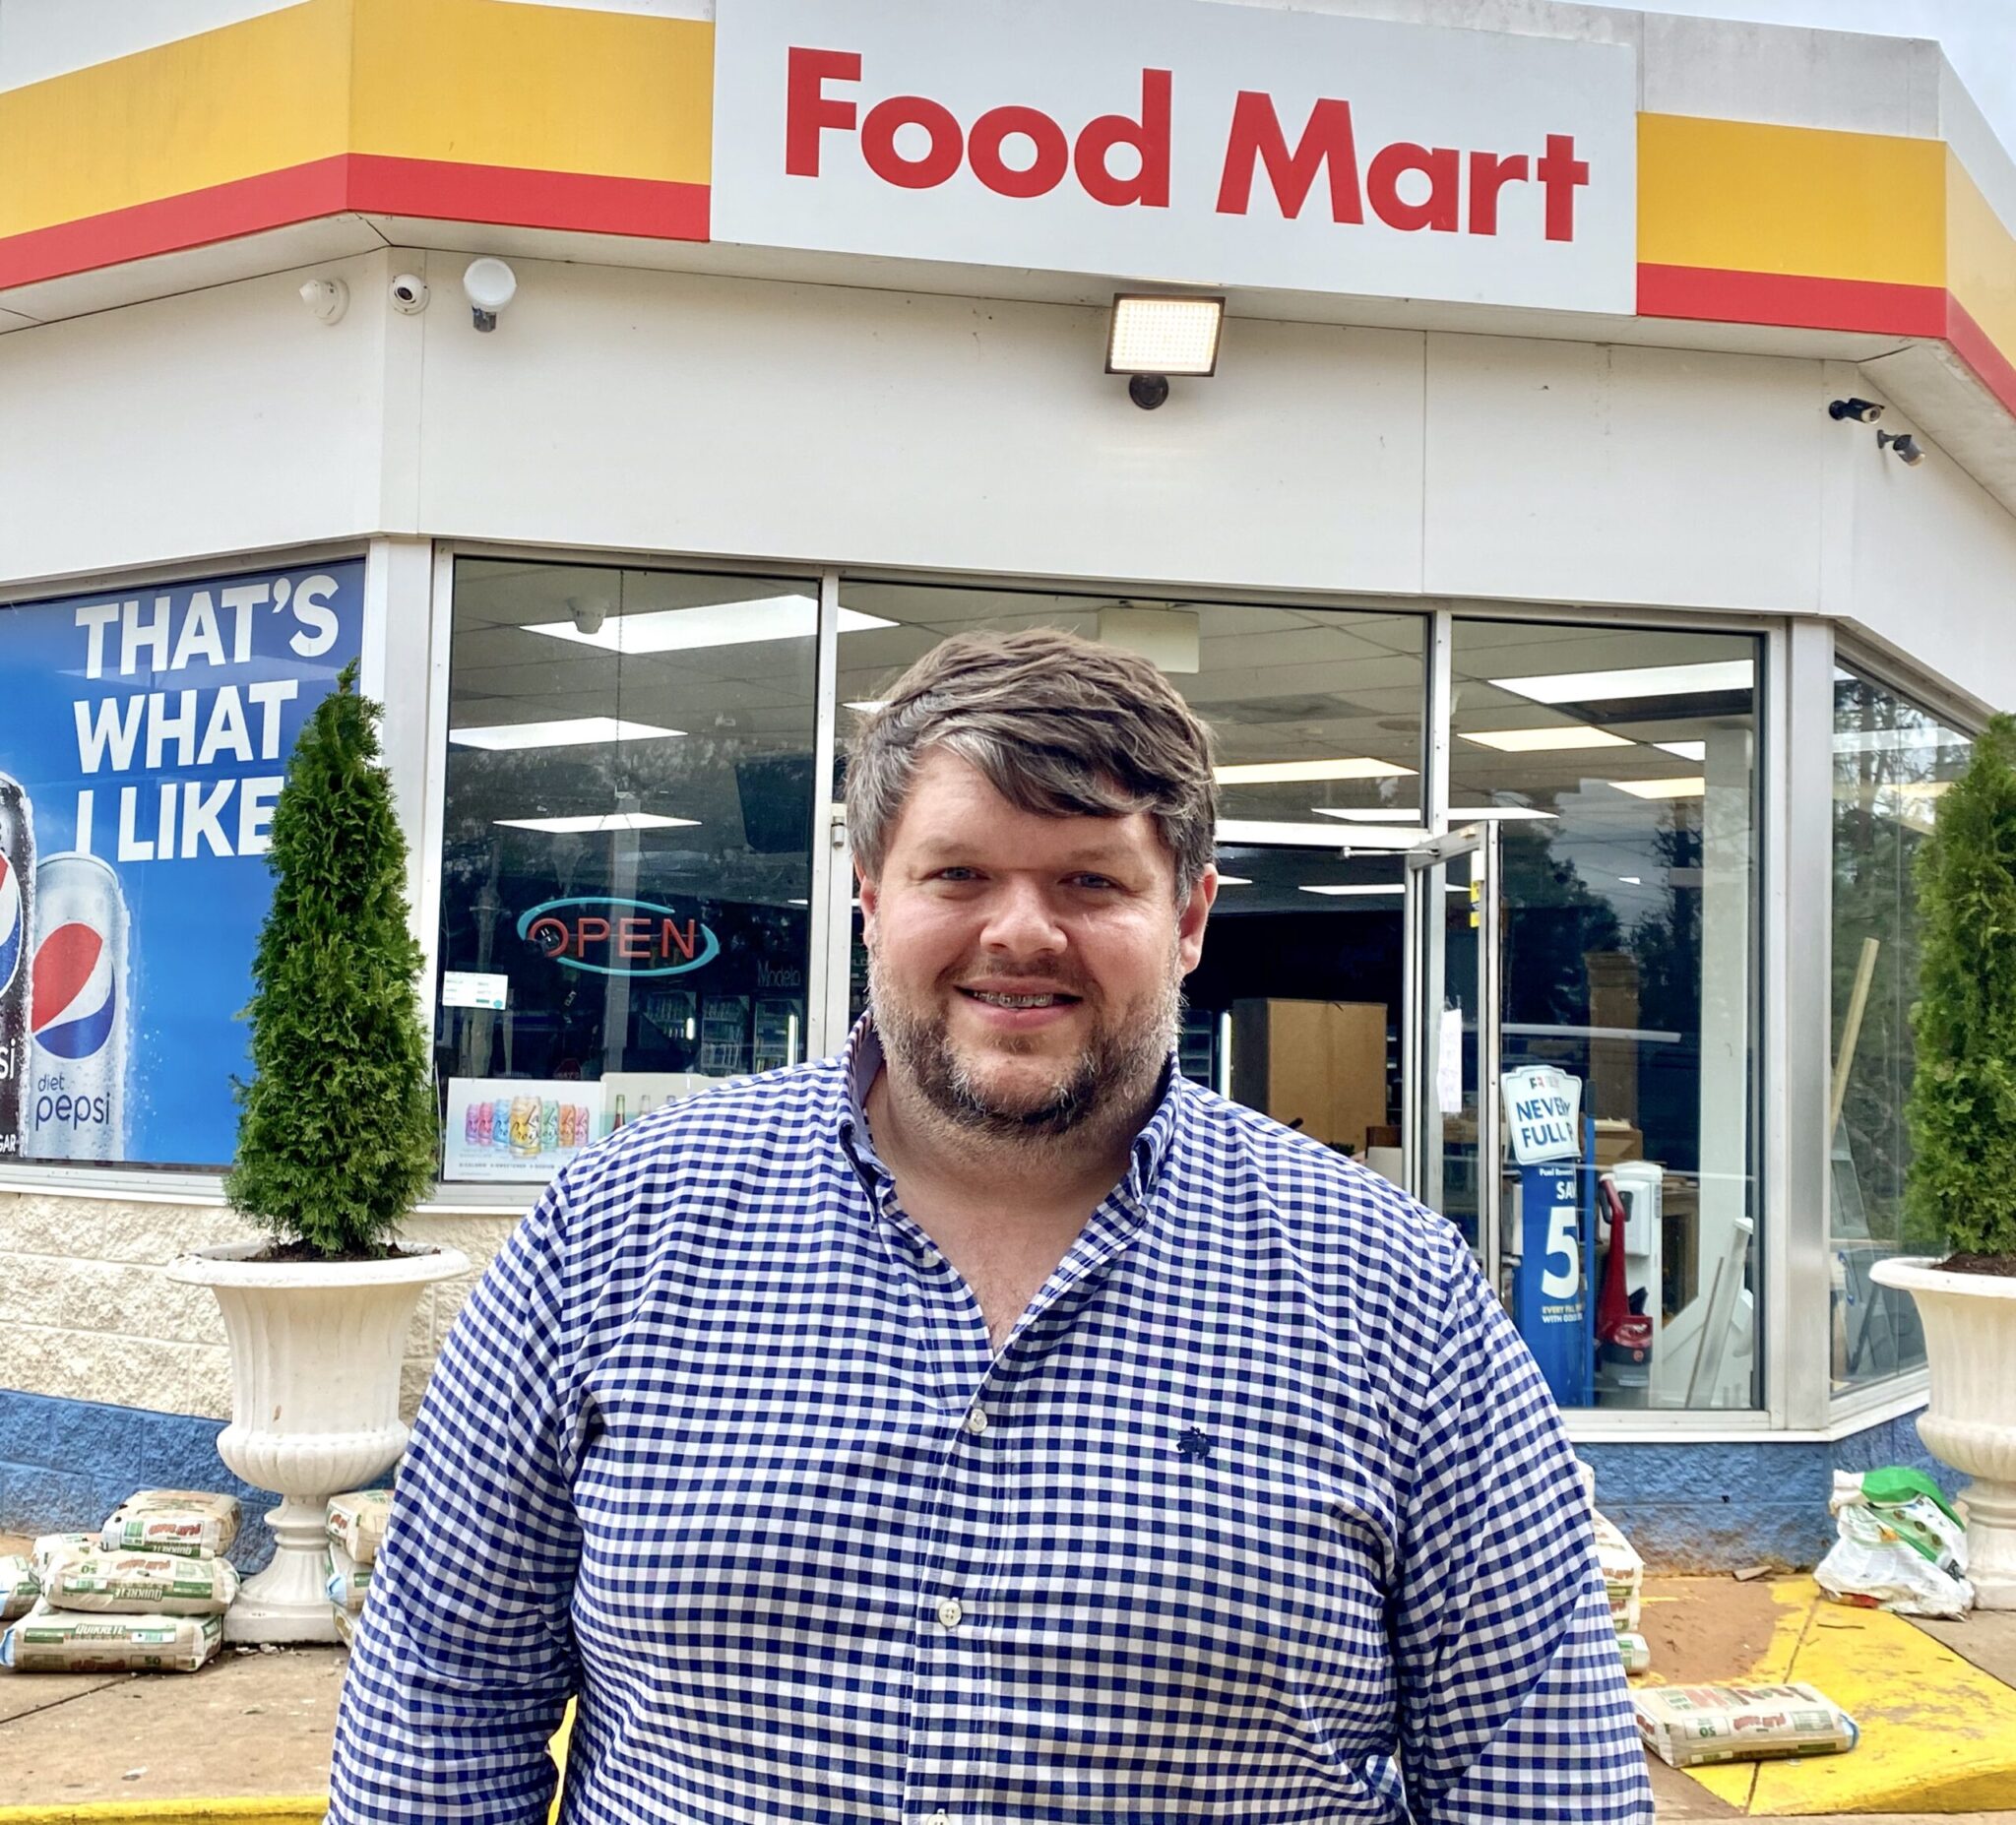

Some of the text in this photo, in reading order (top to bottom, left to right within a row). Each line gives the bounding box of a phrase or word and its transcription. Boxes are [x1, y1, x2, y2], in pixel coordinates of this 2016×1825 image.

[786, 46, 1589, 241] Food Mart
[75, 574, 340, 679] THAT'S
[73, 679, 298, 775] WHAT
[75, 776, 284, 862] I LIKE
[528, 917, 695, 959] OPEN
[35, 1092, 110, 1131] pepsi
[38, 1073, 65, 1092] diet
[1542, 1206, 1579, 1299] 5
